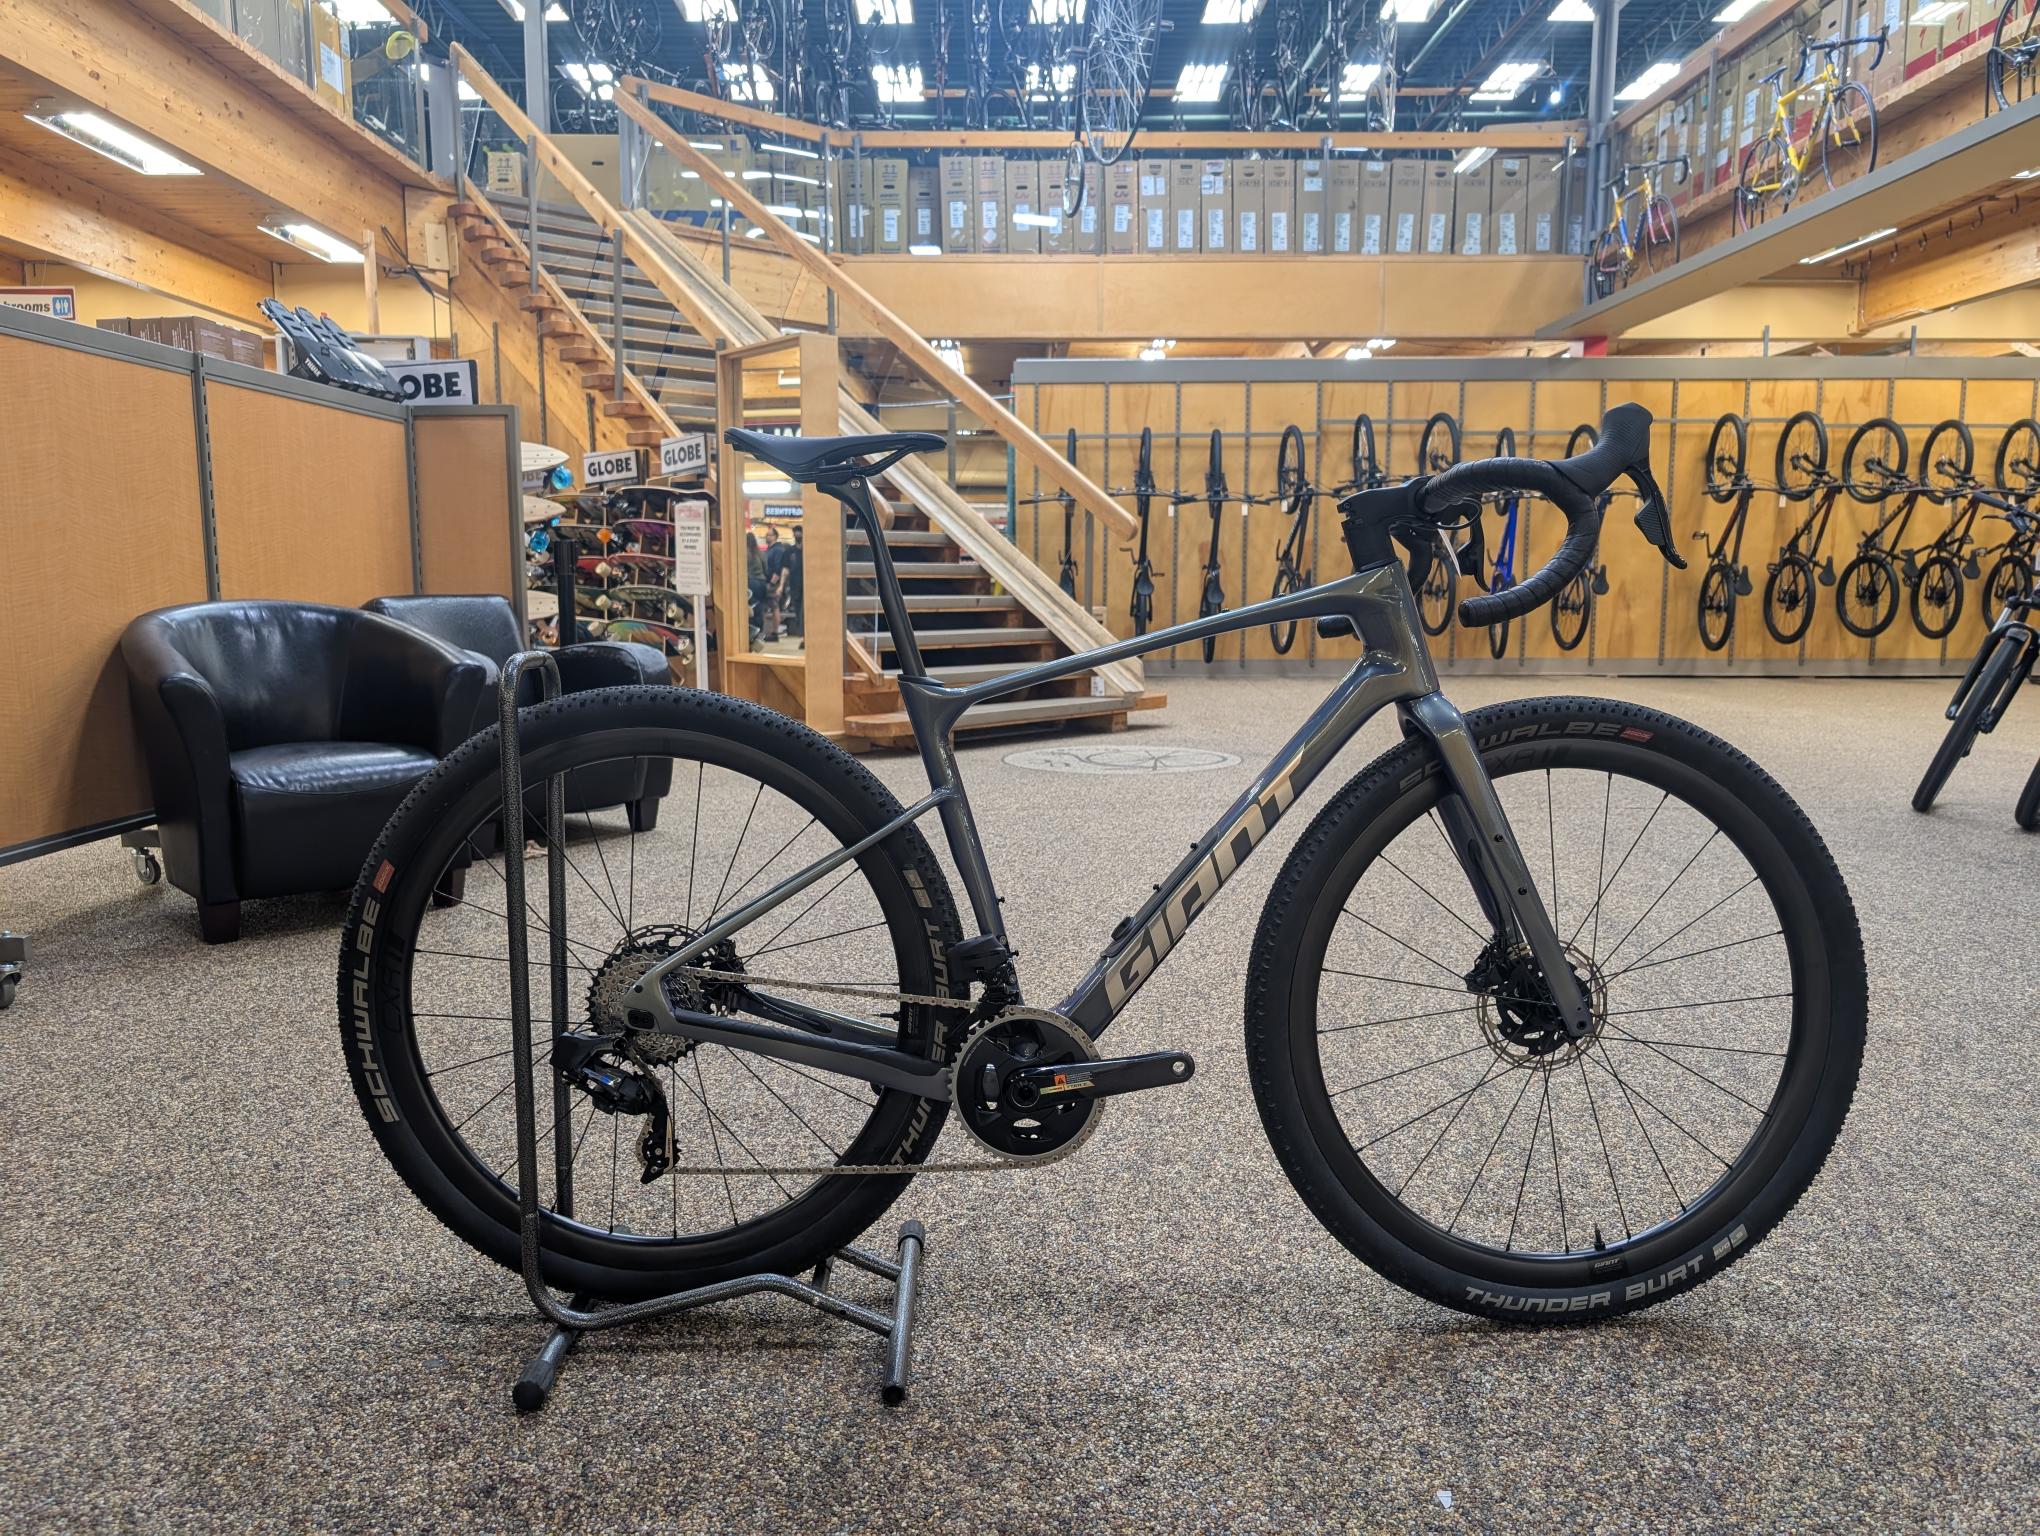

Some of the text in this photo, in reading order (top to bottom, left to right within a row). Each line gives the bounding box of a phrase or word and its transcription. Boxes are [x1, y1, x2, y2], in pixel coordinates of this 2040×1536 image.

[398, 371, 463, 400] OBE
[587, 456, 633, 477] GLOBE
[663, 442, 702, 467] GLOBE
[352, 896, 400, 1123] SCHWALBE
[1465, 1286, 1611, 1313] THUNDER
[1625, 1254, 1704, 1301] BURT
